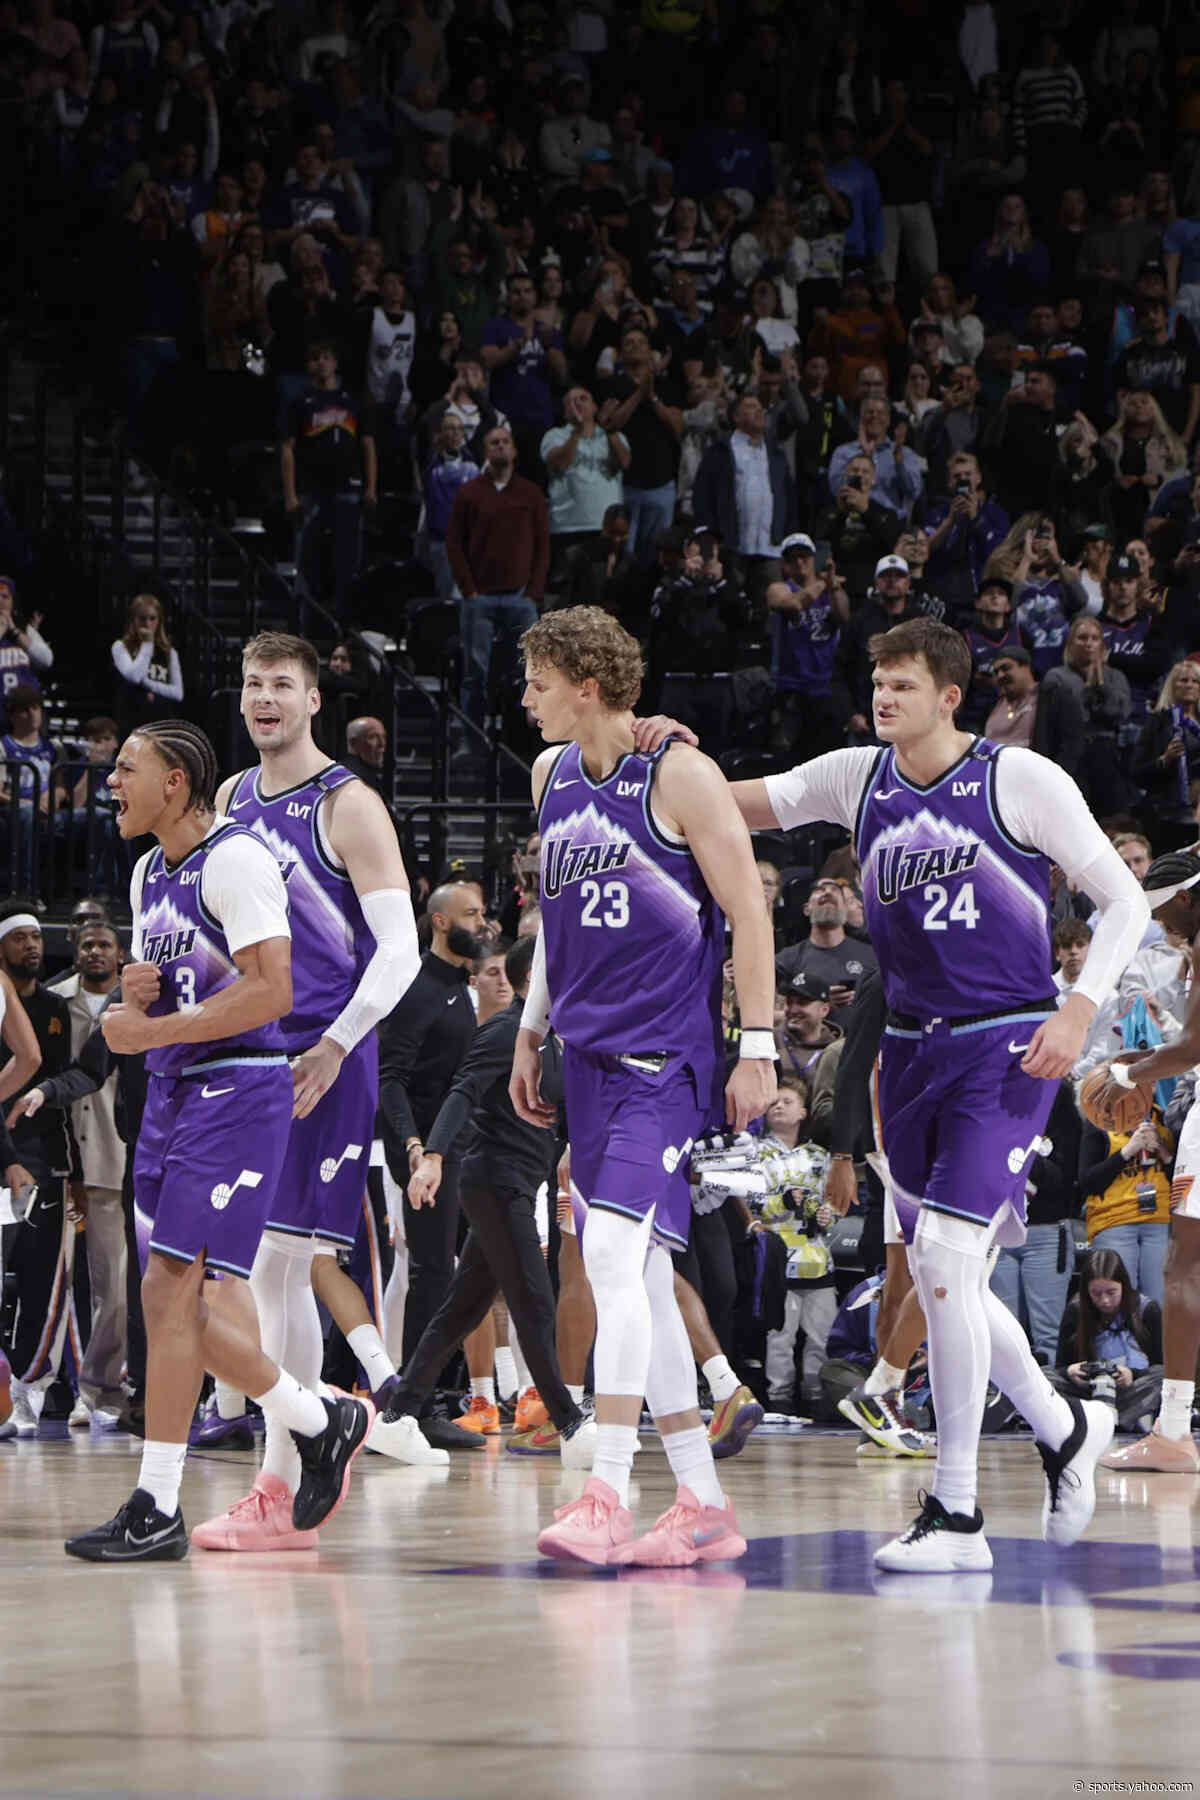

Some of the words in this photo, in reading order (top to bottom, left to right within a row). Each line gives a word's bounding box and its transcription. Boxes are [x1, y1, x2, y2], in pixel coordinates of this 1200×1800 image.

[286, 801, 312, 820] LVT
[616, 781, 643, 797] LVT
[952, 781, 982, 797] LVT
[179, 871, 200, 885] LVT
[544, 837, 637, 899] UTAH
[877, 841, 985, 905] UTAH
[580, 880, 630, 928] 23
[923, 882, 981, 930] 24
[175, 967, 196, 1013] 3
